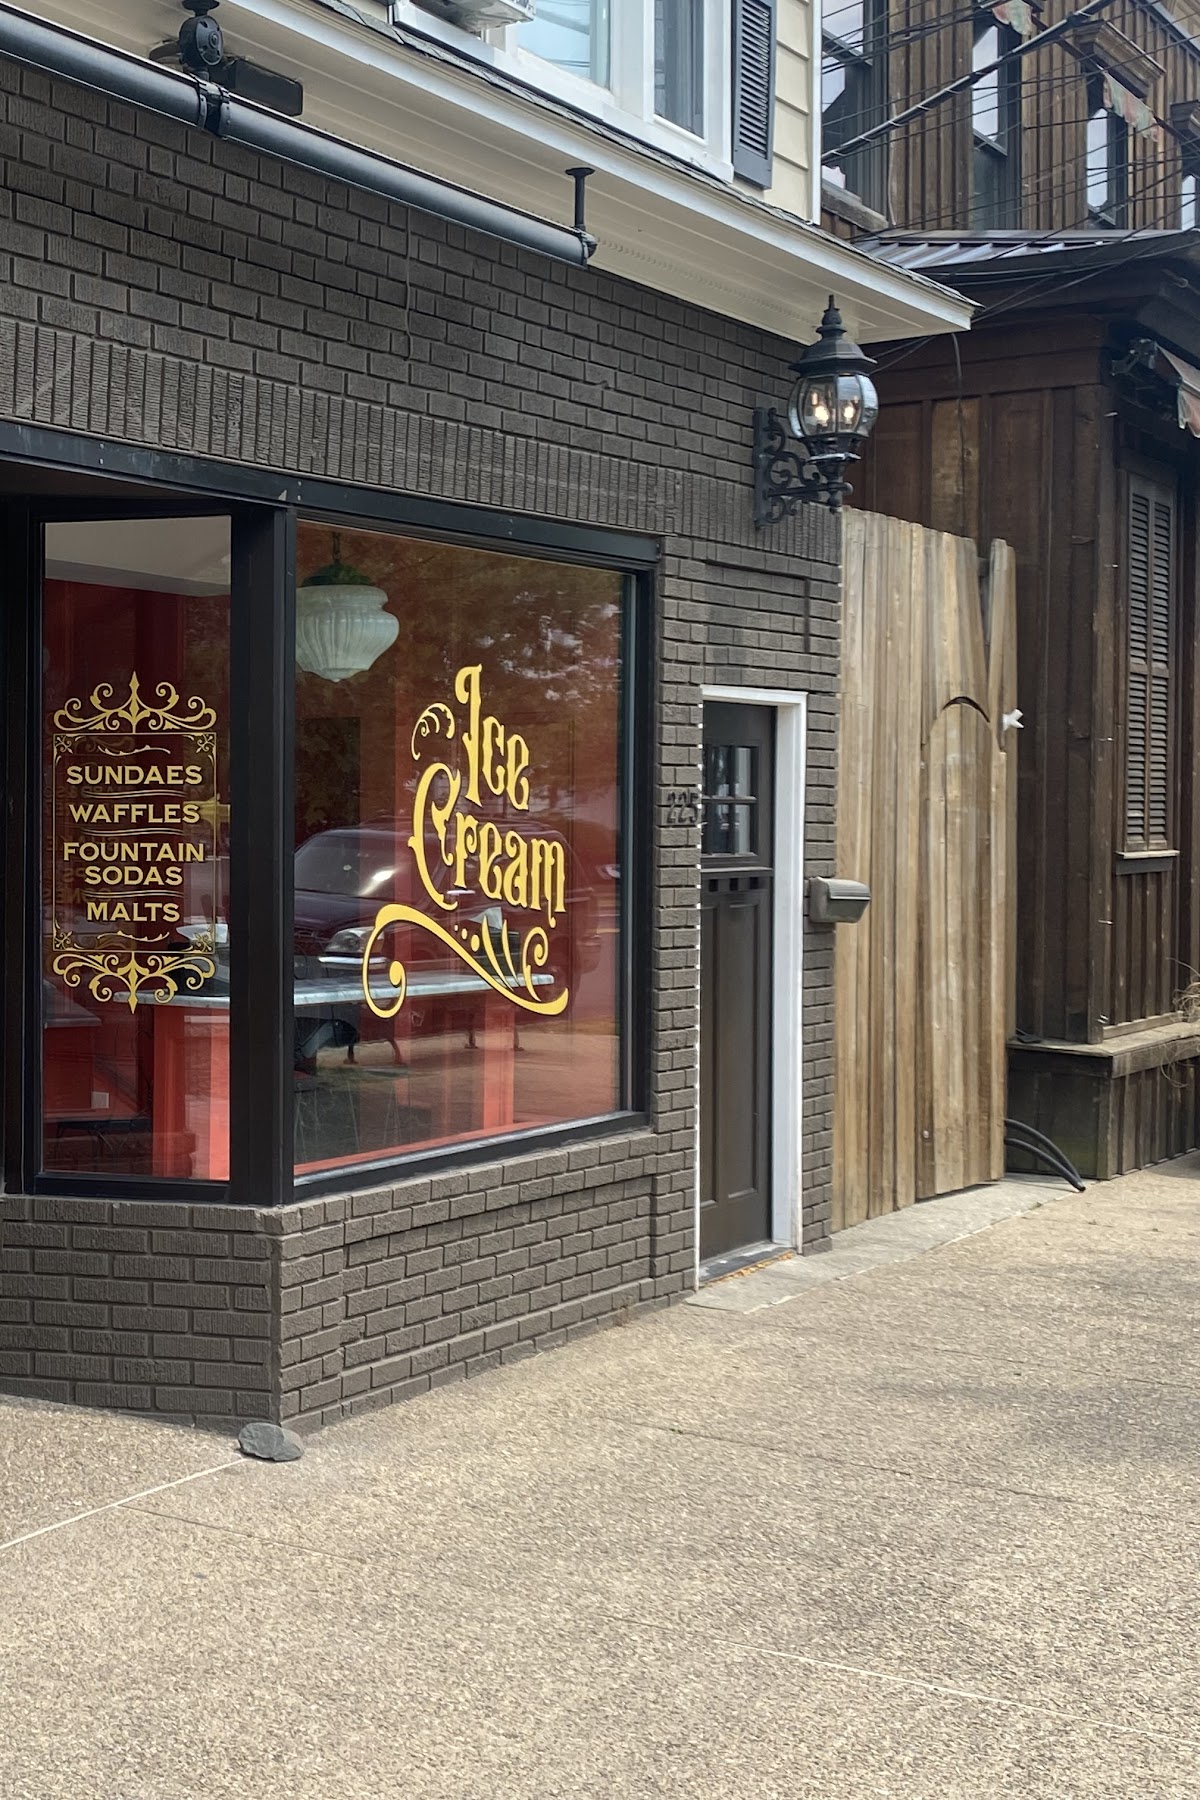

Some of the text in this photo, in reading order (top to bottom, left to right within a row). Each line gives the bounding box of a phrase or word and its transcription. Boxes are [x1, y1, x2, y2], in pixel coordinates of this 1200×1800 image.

[454, 663, 530, 811] Ice
[66, 765, 203, 785] SUNDAES
[69, 803, 200, 824] WAFFLES
[666, 791, 699, 823] 225
[63, 842, 204, 863] FOUNTAIN
[407, 762, 566, 928] Cream
[84, 866, 183, 886] SODAS
[86, 902, 180, 922] MALTS
